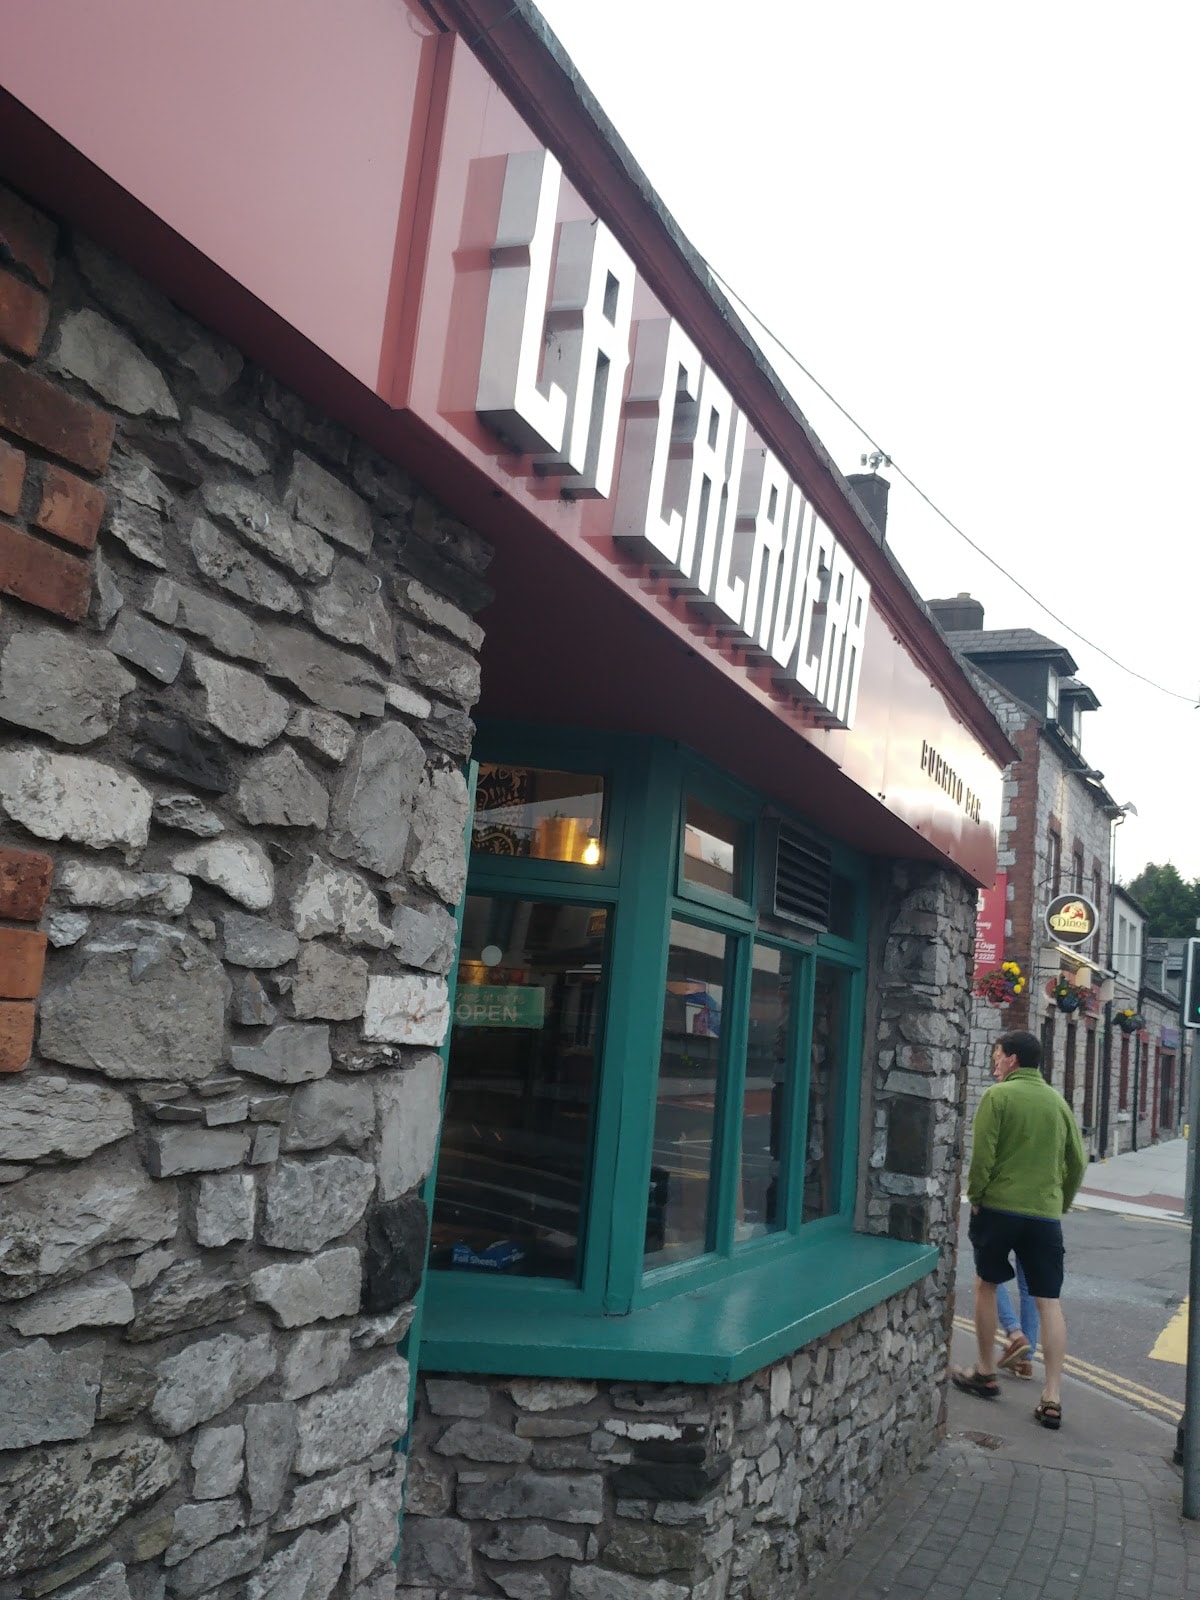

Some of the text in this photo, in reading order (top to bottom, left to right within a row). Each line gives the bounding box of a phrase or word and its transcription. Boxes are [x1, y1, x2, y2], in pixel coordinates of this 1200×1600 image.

[514, 148, 871, 731] LA CALAVERA
[920, 739, 981, 825] BURRITO BAR
[456, 1004, 517, 1022] OPEN
